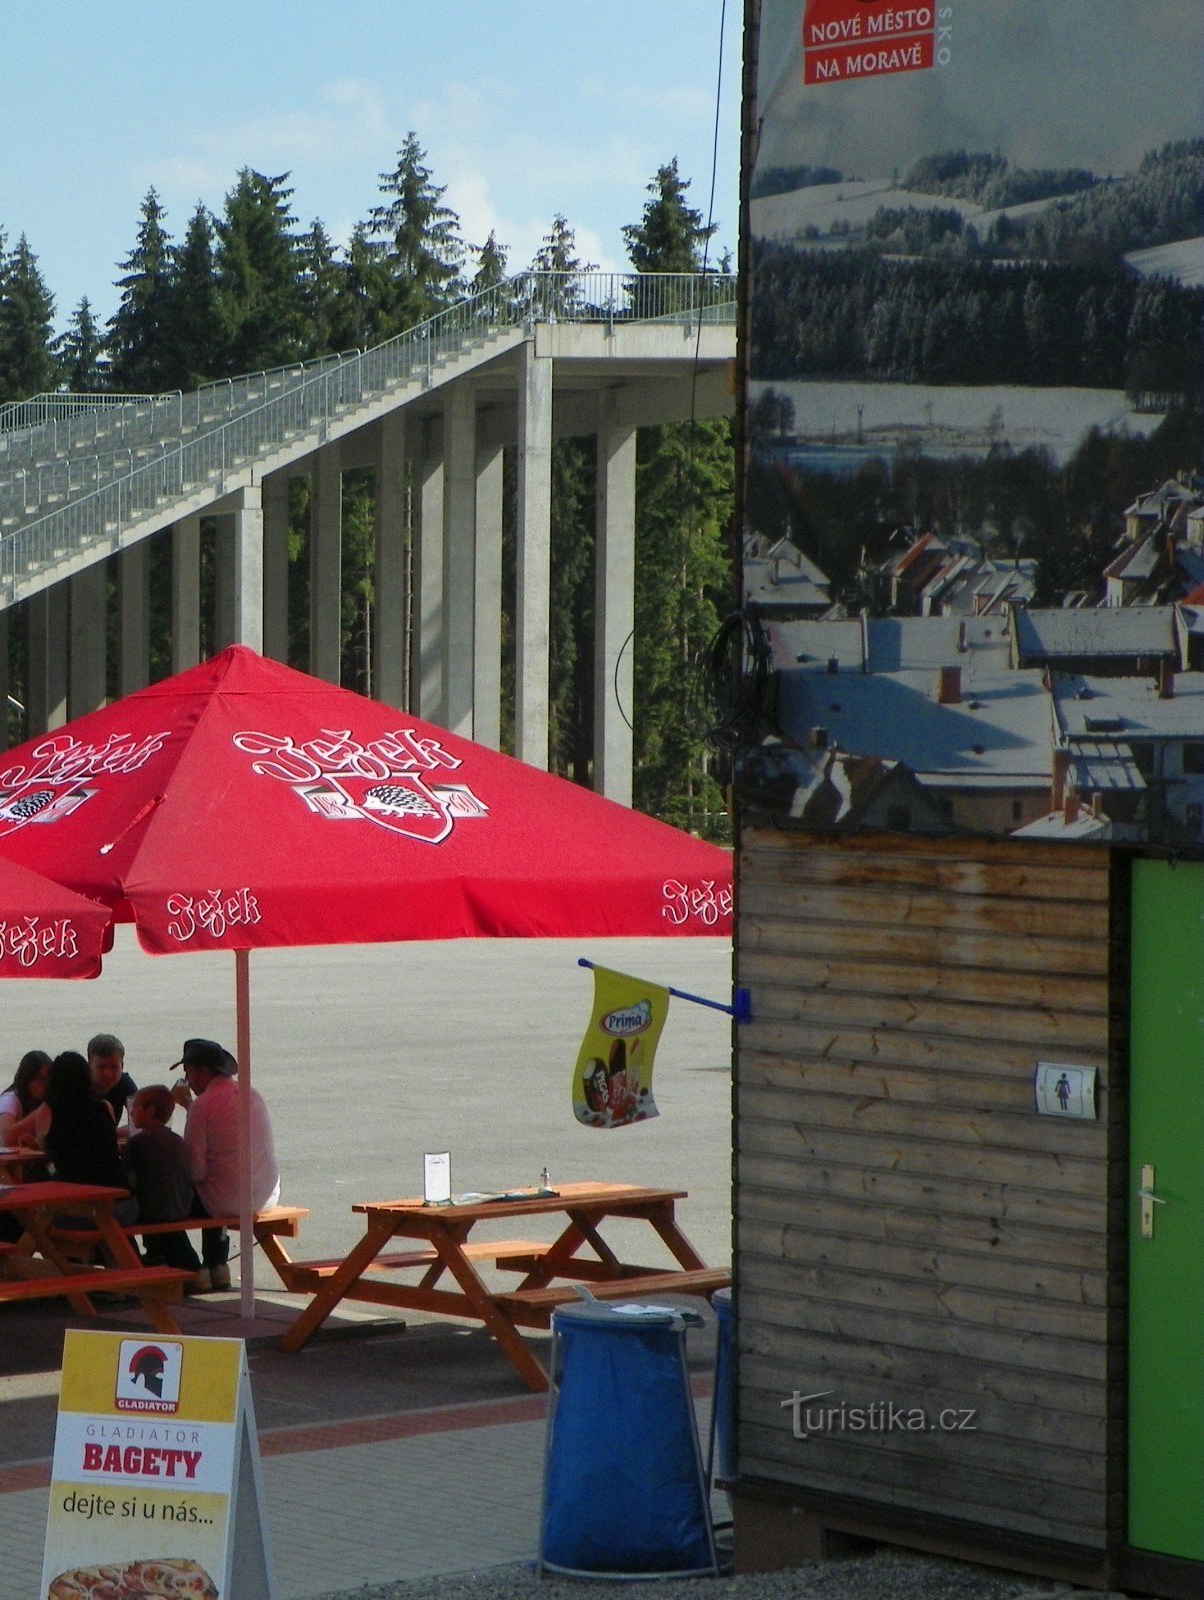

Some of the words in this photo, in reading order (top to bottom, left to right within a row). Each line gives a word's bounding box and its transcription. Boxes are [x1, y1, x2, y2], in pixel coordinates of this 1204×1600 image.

[811, 13, 862, 42] NOVÉ
[868, 8, 931, 34] MĚSTO
[816, 58, 840, 78] NA
[846, 42, 922, 74] MORAVĚ
[232, 728, 463, 783] Ježek
[167, 887, 262, 941] Ježek
[662, 879, 733, 925] Ježe
[608, 1013, 642, 1029] Prima
[118, 1400, 176, 1412] GLADIATOR
[86, 1424, 199, 1444] GLADIATOR
[83, 1443, 202, 1478] BAGETY
[63, 1492, 115, 1520] dejte
[121, 1497, 137, 1517] si
[143, 1503, 155, 1518] u
[162, 1501, 214, 1524] nás...
